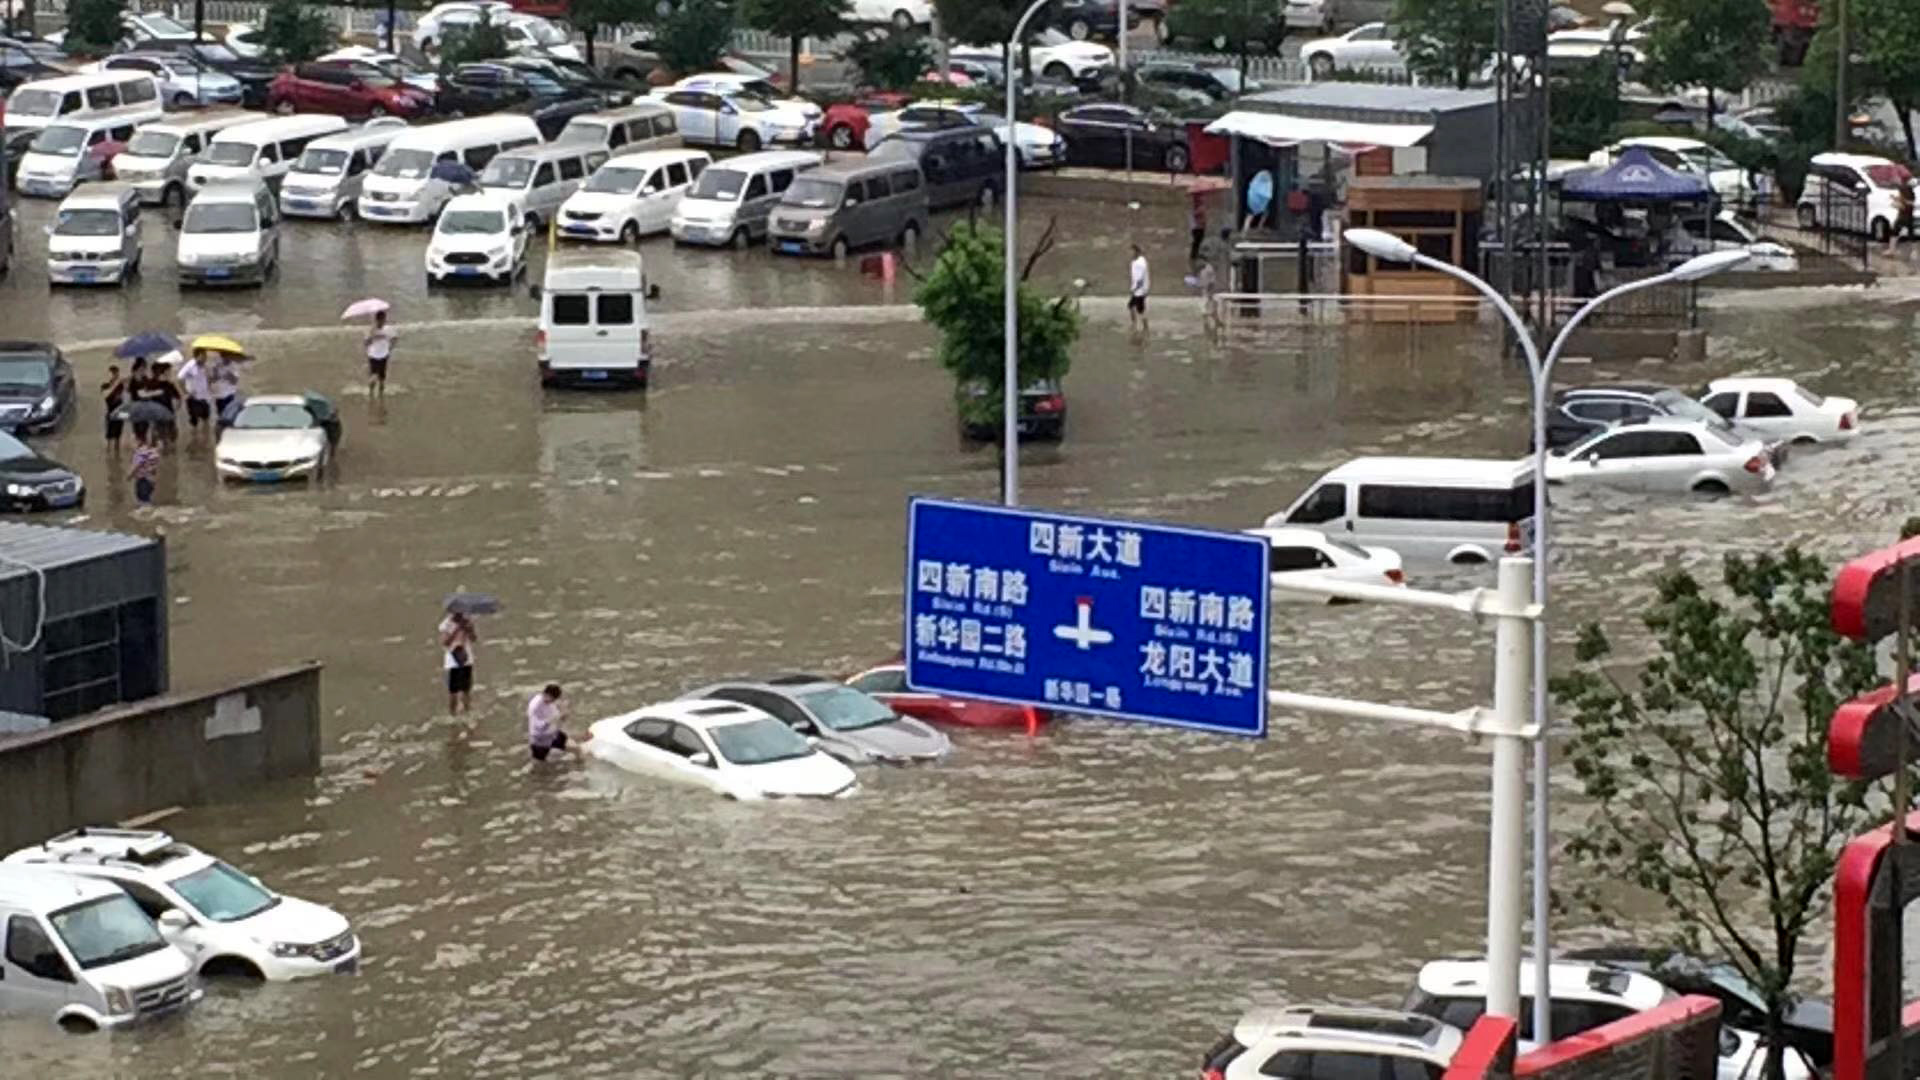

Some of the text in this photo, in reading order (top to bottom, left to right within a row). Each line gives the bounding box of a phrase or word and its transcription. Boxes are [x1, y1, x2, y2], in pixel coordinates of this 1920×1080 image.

[1029, 521, 1142, 567] 四新大道
[918, 559, 1029, 605] 四新南路
[1140, 585, 1255, 632] 四新南路
[916, 612, 1026, 659] 新华园二路
[1139, 640, 1254, 688] 龙阳大道
